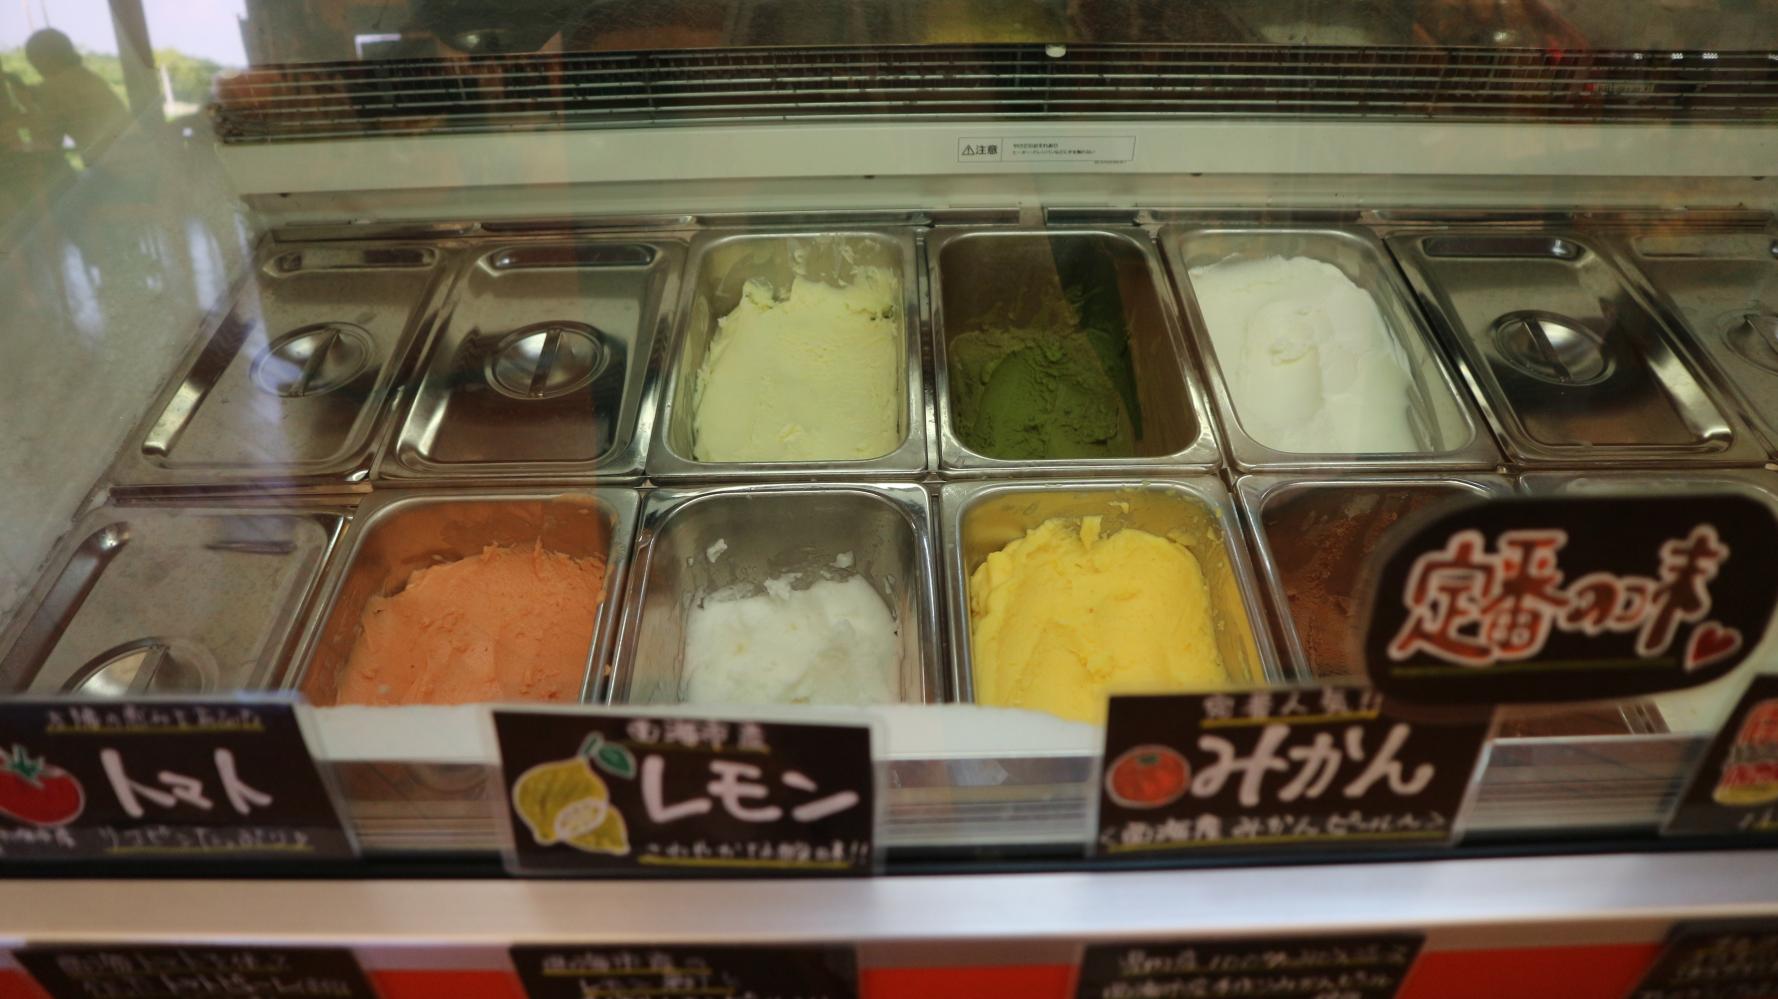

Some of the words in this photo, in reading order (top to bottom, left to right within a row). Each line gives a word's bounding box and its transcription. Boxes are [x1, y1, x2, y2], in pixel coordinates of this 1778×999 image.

[975, 143, 998, 155] 注意
[1387, 523, 1730, 666] 定番の味
[100, 747, 273, 819] トマト
[641, 754, 860, 824] レモン
[1190, 722, 1436, 808] みかん
